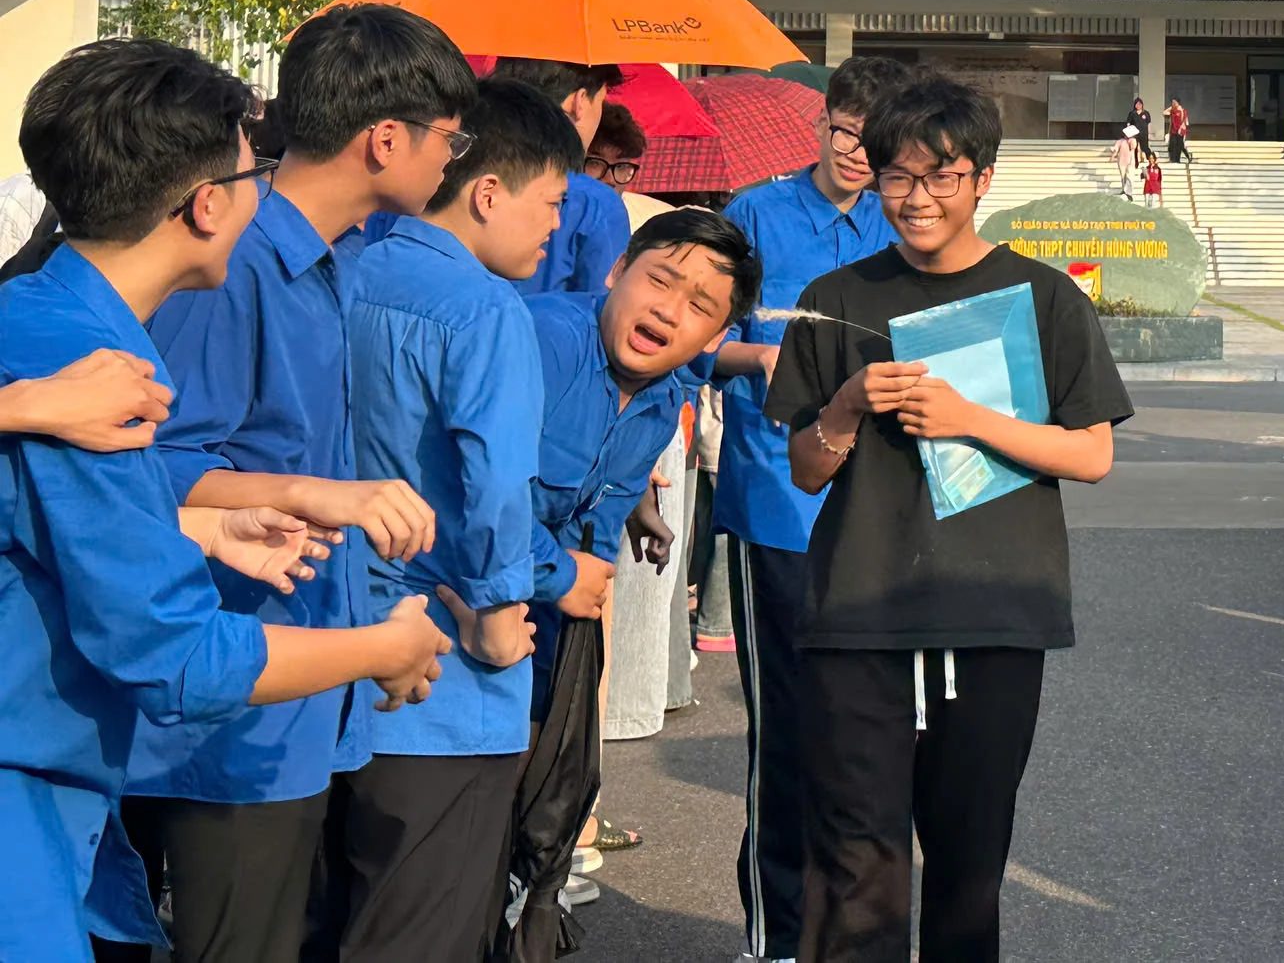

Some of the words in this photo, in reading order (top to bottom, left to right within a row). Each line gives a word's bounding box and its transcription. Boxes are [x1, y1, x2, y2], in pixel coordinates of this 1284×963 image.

[611, 17, 688, 35] LPBank
[1039, 239, 1064, 258] THPT
[1065, 237, 1104, 258] CHUYÊN
